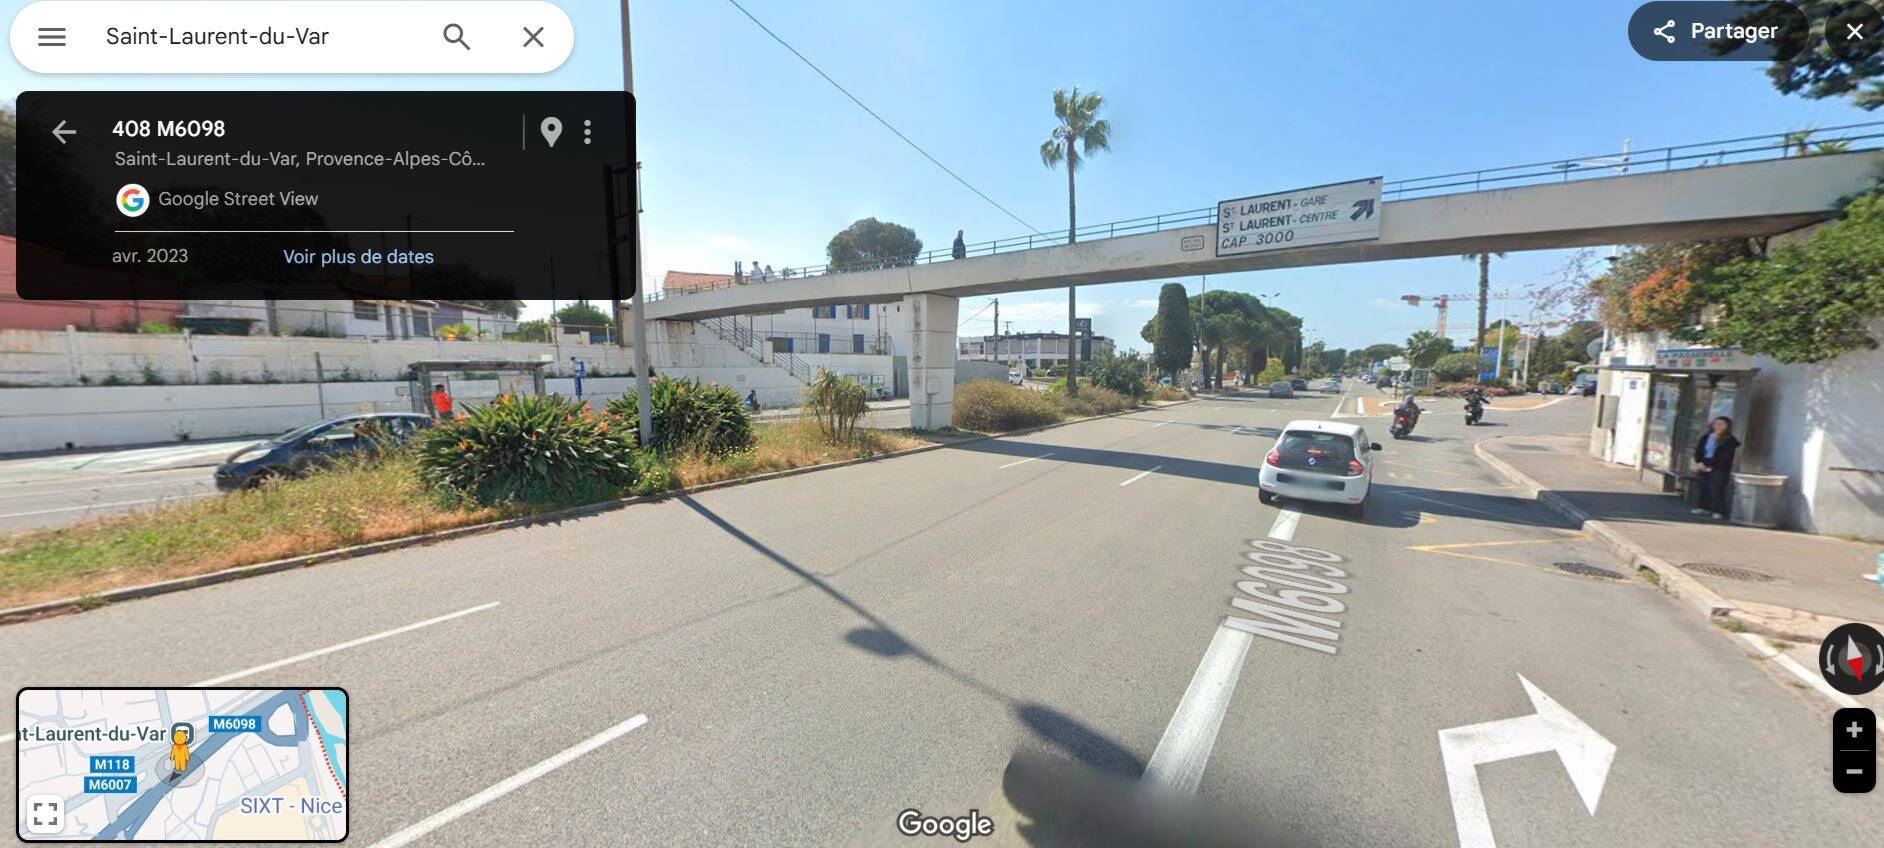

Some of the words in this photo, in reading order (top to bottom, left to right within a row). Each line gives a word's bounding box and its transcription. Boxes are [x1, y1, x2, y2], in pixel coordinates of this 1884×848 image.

[1240, 199, 1292, 217] LAURENT
[1300, 194, 1328, 208] GARE
[1239, 214, 1292, 232] LAURENT
[1299, 209, 1340, 225] CENTRE
[1221, 236, 1248, 250] CAP
[1255, 230, 1295, 246] 3000
